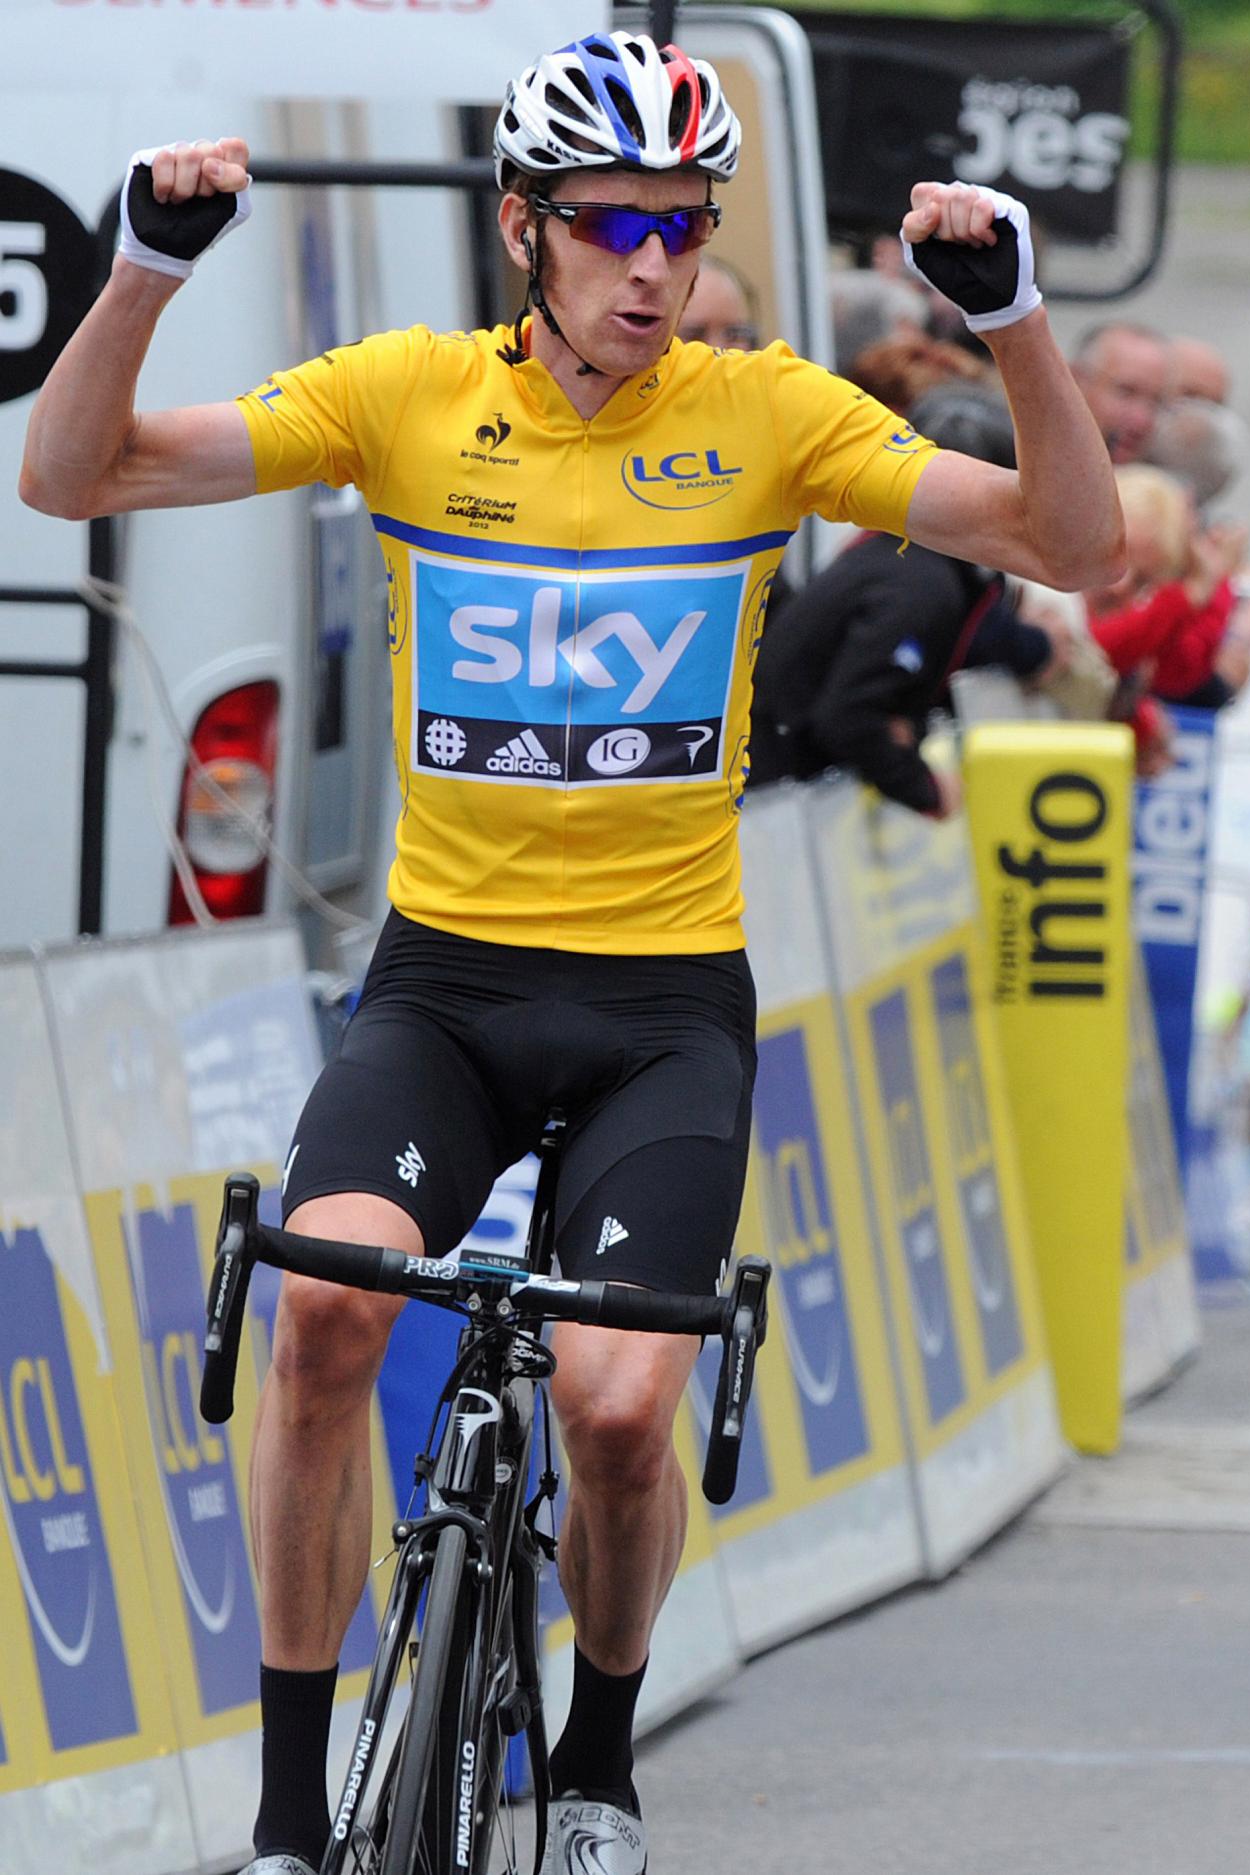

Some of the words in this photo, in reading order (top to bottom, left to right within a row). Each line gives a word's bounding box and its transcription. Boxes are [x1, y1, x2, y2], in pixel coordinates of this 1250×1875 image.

[547, 140, 583, 164] KASK
[460, 449, 469, 458] le
[469, 452, 487, 464] coq
[488, 455, 520, 466] sportif
[631, 449, 743, 482] LCL
[676, 478, 734, 490] BANQUE
[468, 521, 489, 530] 2012
[449, 587, 707, 713] sky
[602, 736, 638, 763] IG
[486, 756, 562, 777] adidas
[996, 772, 1108, 997] info
[395, 1141, 426, 1188] sky
[596, 1216, 612, 1255] adidas
[404, 1256, 459, 1280] PRO
[0, 1355, 85, 1503] LCL
[325, 1718, 377, 1841] PINARELLO
[456, 1740, 476, 1868] PINARELLO
